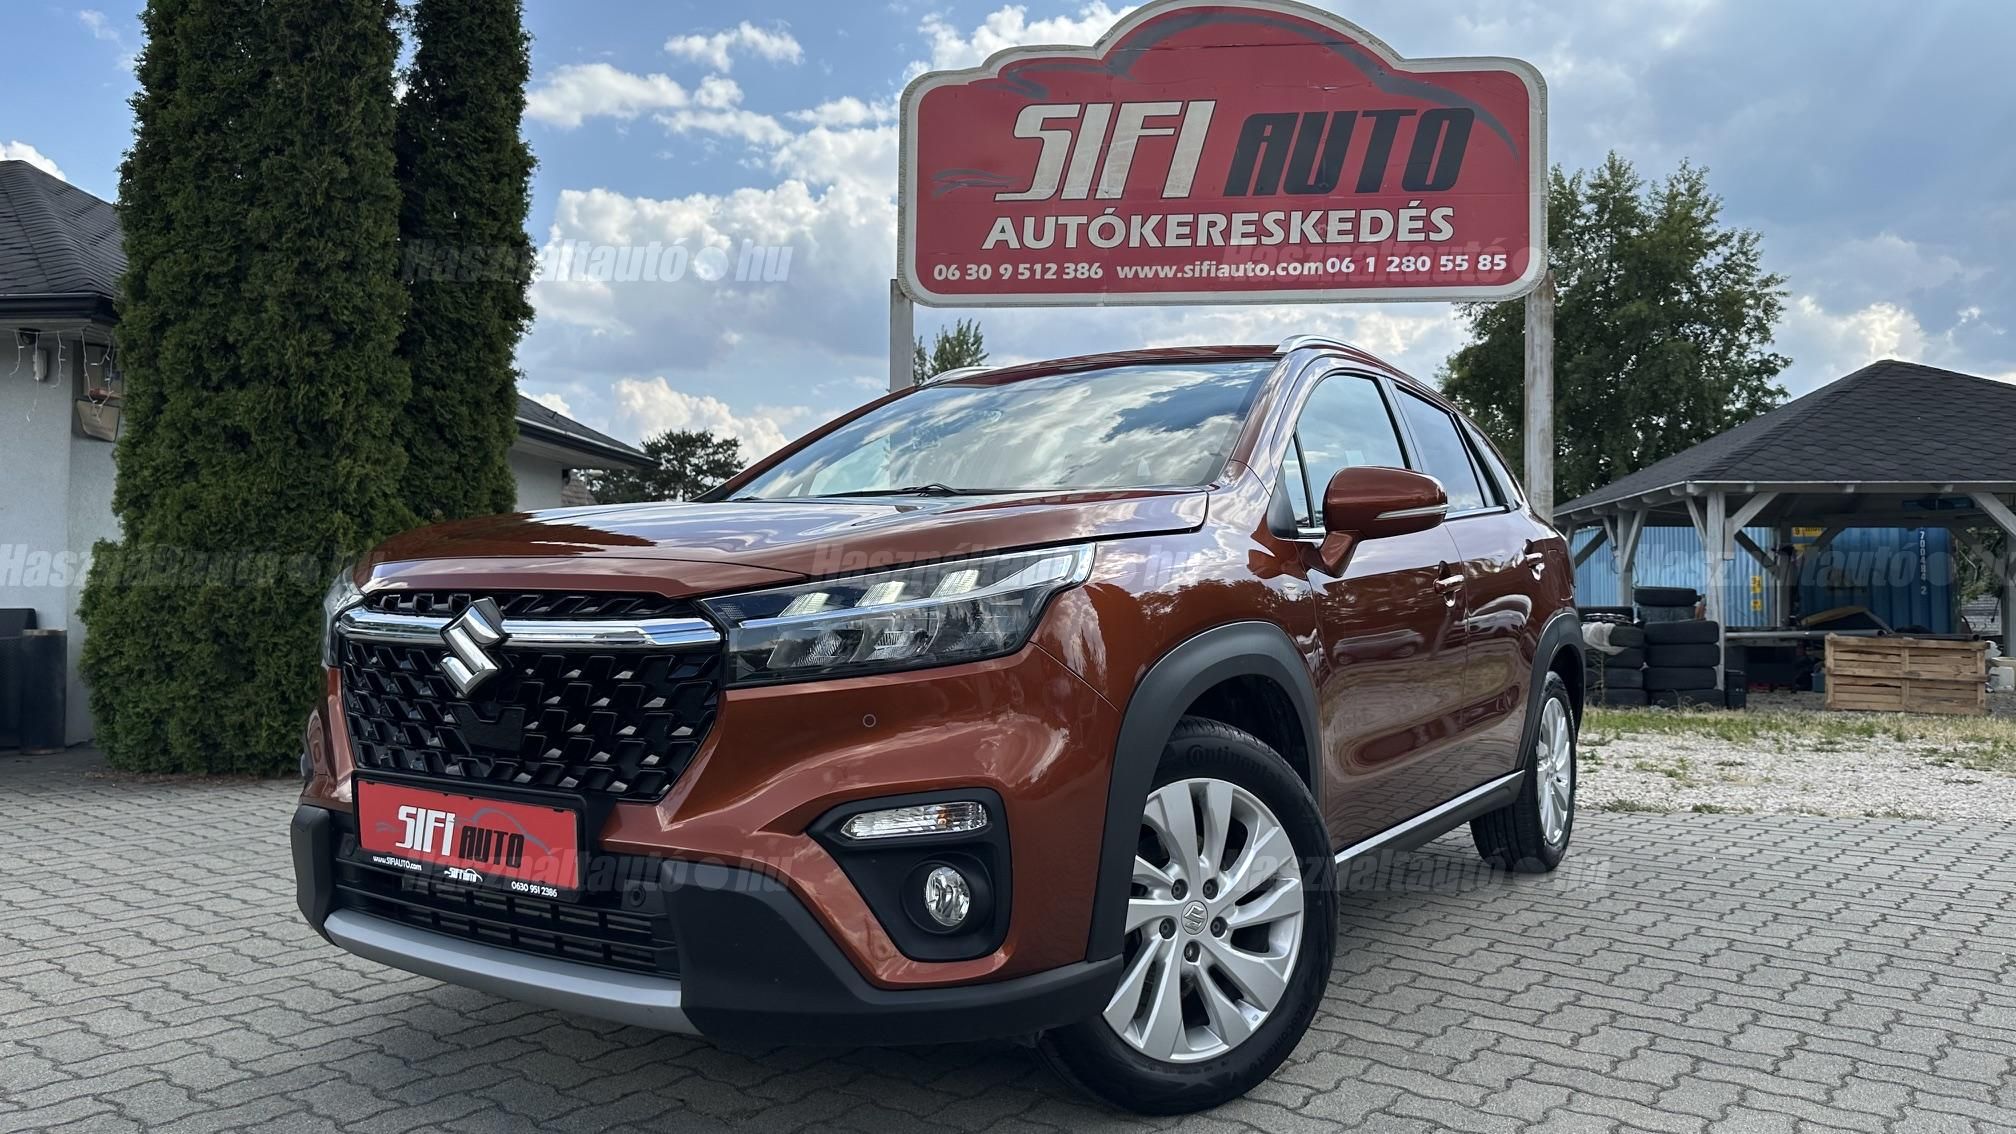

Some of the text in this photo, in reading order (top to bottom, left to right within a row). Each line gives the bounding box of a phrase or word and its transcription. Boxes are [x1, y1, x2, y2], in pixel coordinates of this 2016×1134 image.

[994, 100, 1476, 202] SIFI AUTO
[982, 201, 1456, 250] AUTÓKERESKEDÉS
[933, 254, 1507, 280] 06 30 9 512 386 www.sifiauto.com 06 1 280 55 85
[459, 826, 525, 869] AUTO
[511, 881, 529, 892] 0630
[530, 885, 540, 894] 951
